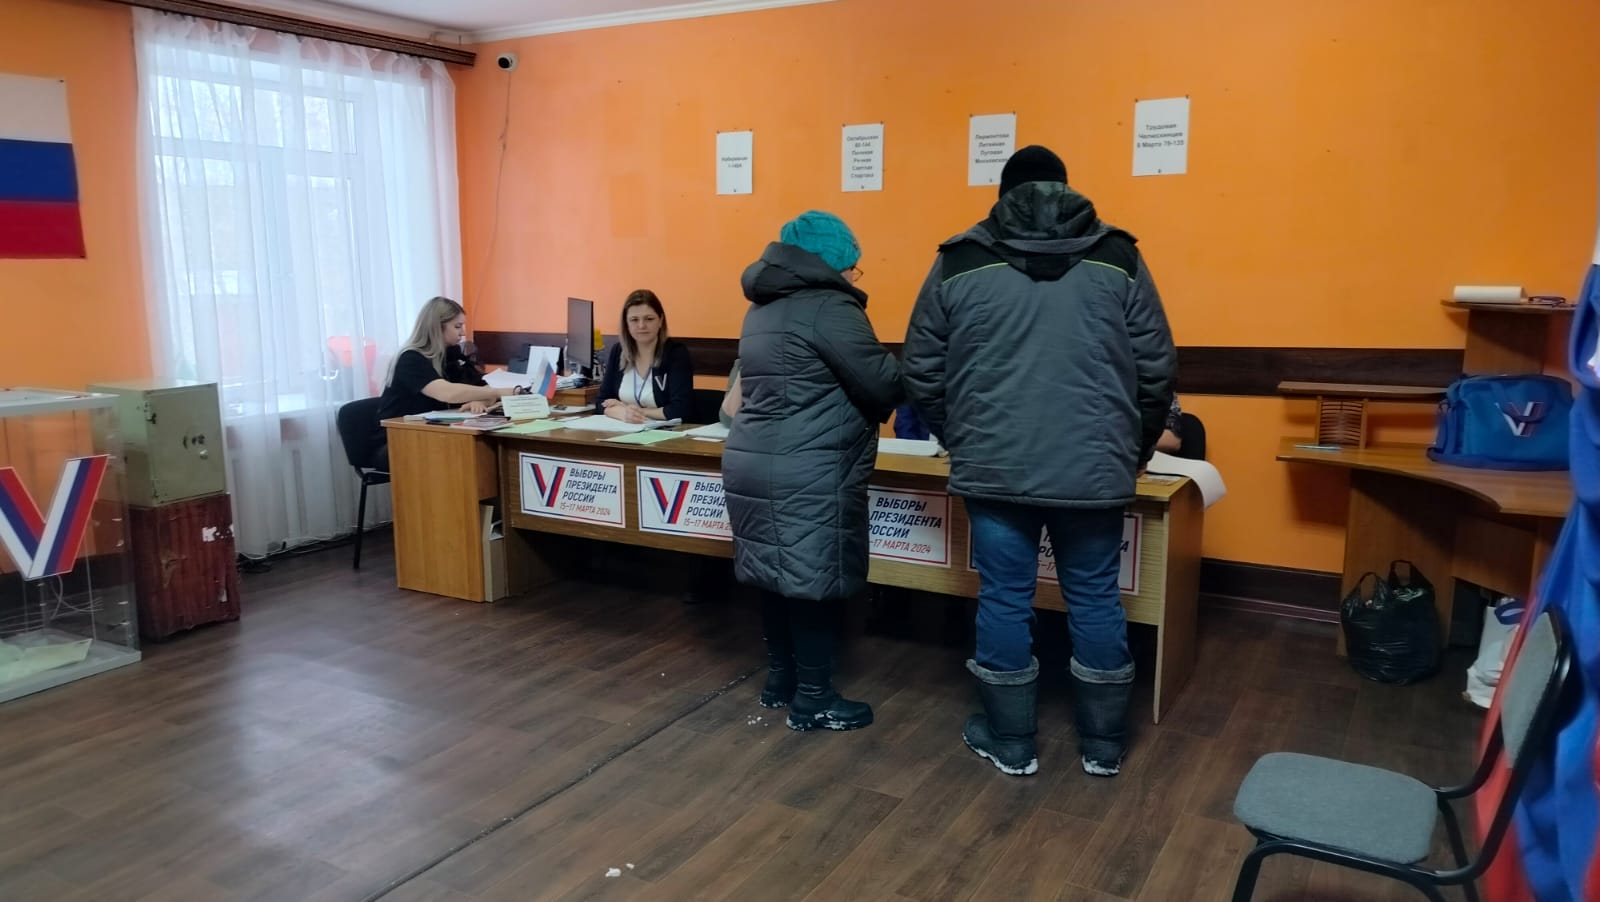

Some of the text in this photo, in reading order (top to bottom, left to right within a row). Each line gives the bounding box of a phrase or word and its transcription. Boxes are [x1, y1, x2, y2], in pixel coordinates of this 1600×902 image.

[569, 467, 606, 481] ВЫБОРЫ
[565, 479, 618, 495] ПРЕЗИДЕНТА
[694, 480, 725, 494] ВЫБО
[561, 490, 596, 504] РОССИИ
[690, 493, 727, 508] ПРЕЗИД
[575, 504, 596, 514] МАРТА
[875, 497, 927, 513] ВЫБОРЫ
[686, 506, 724, 519] РОССИИ
[870, 510, 943, 529] ПРЕЗИДЕНТА
[701, 519, 725, 530] МАРТА
[881, 540, 911, 551] МАРТА
[910, 543, 932, 555] 2024
